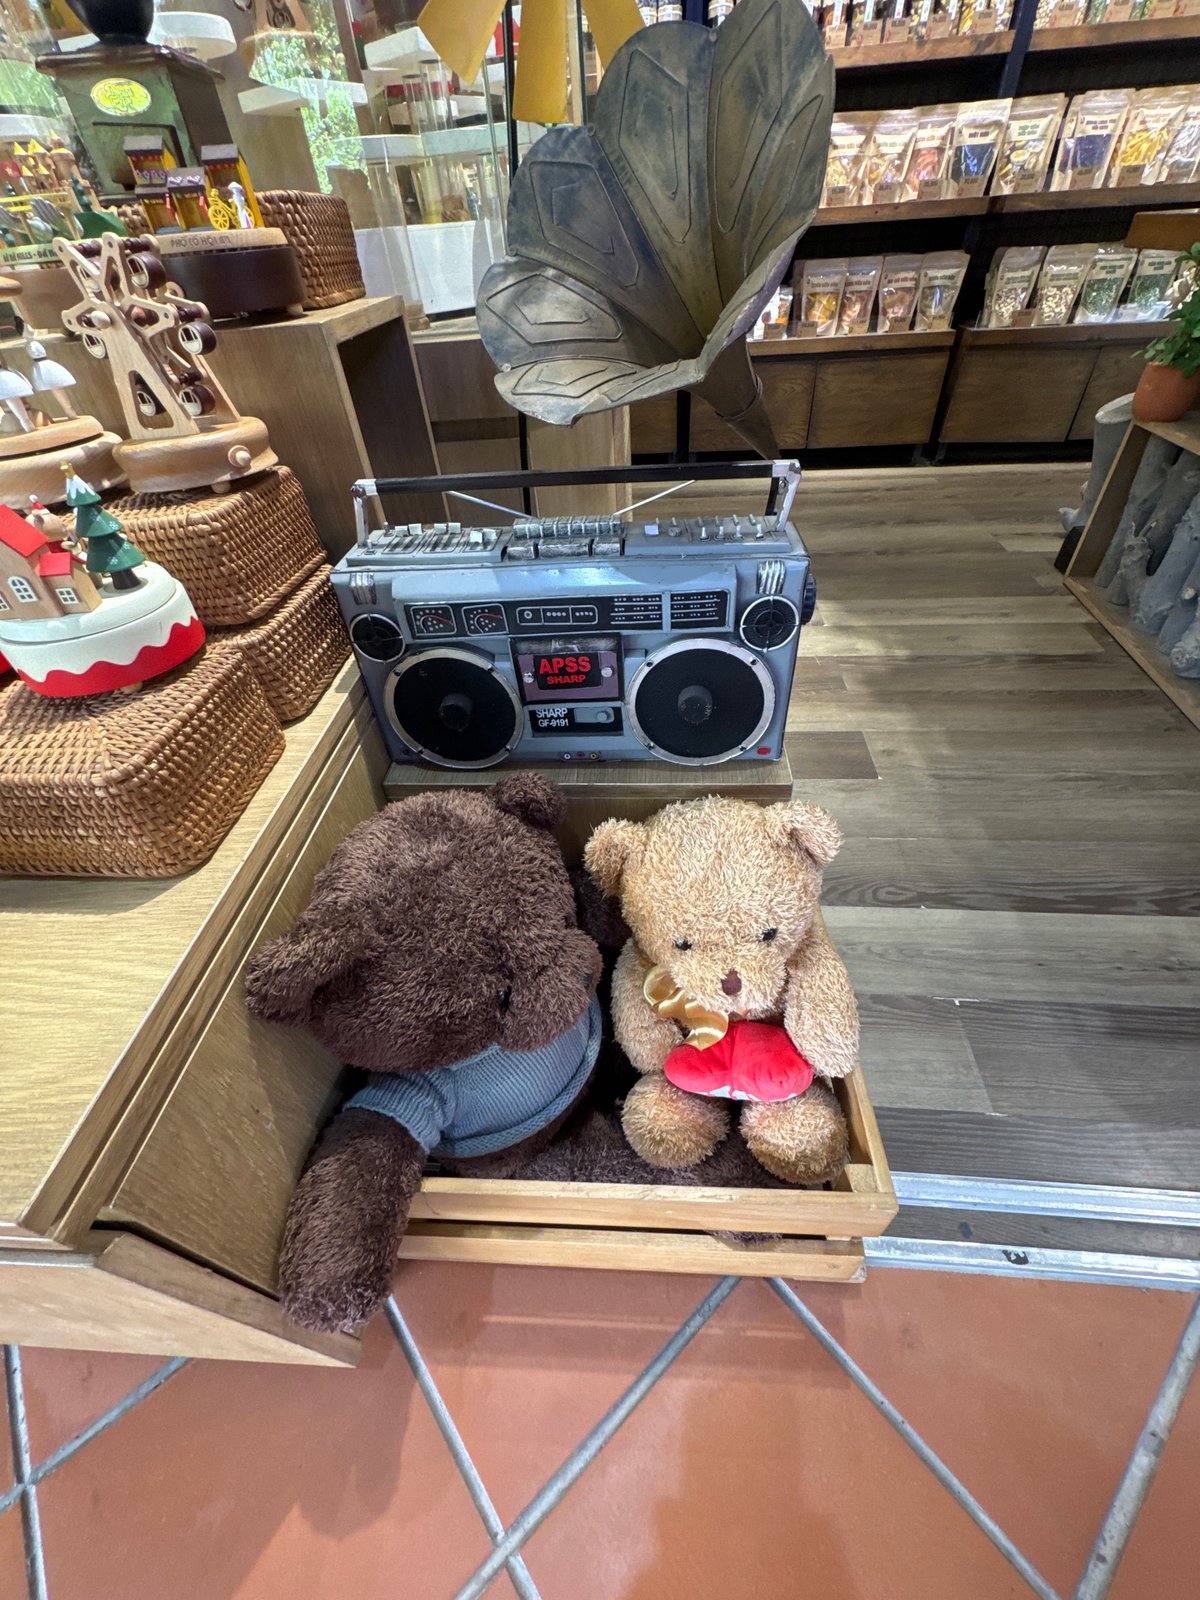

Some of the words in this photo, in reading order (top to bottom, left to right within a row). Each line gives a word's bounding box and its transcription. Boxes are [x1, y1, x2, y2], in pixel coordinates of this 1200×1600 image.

[540, 656, 591, 674] APSS
[547, 675, 586, 685] SHARP
[536, 708, 568, 718] SHARP
[538, 719, 569, 728] GF-9191
